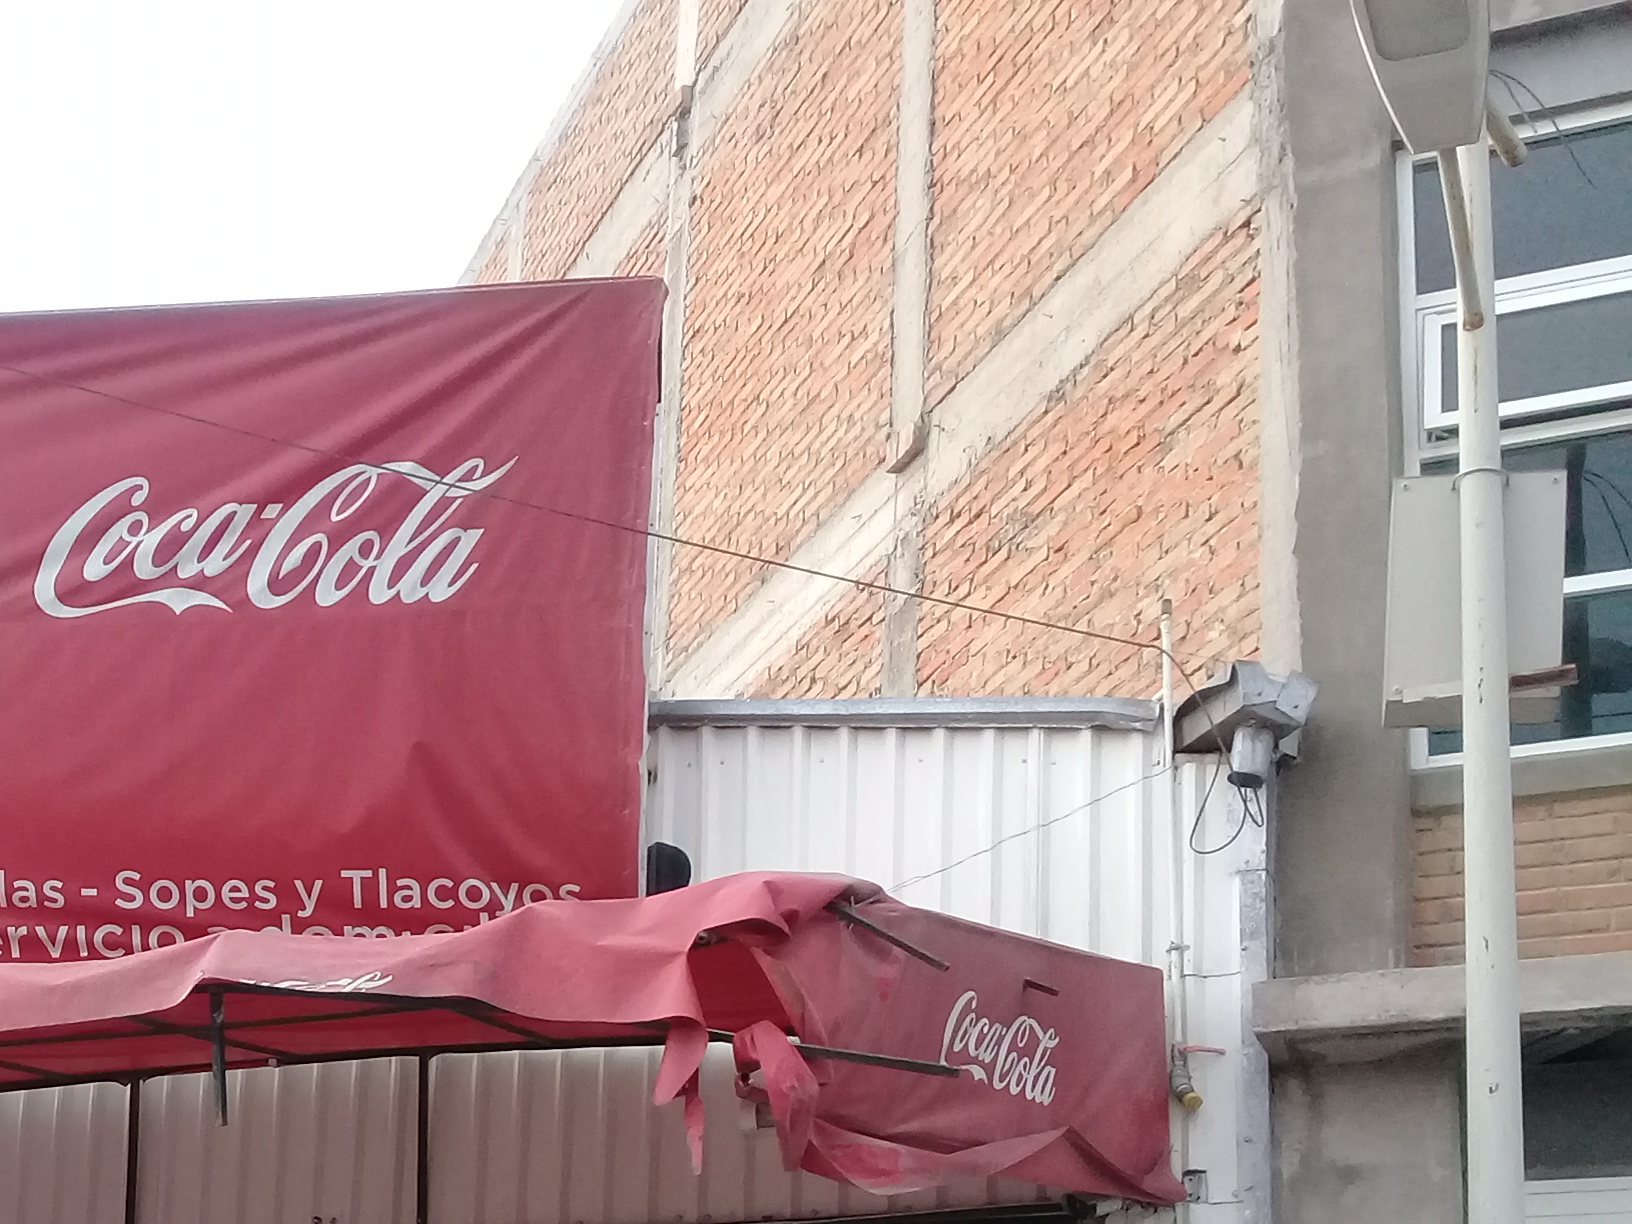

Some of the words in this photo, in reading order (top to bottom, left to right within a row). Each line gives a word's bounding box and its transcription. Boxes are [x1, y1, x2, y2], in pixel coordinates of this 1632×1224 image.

[34, 456, 519, 619] Coca-Cola
[114, 870, 278, 917] Sopes
[293, 878, 323, 917] y
[937, 990, 1060, 1106] Coca-Cola
